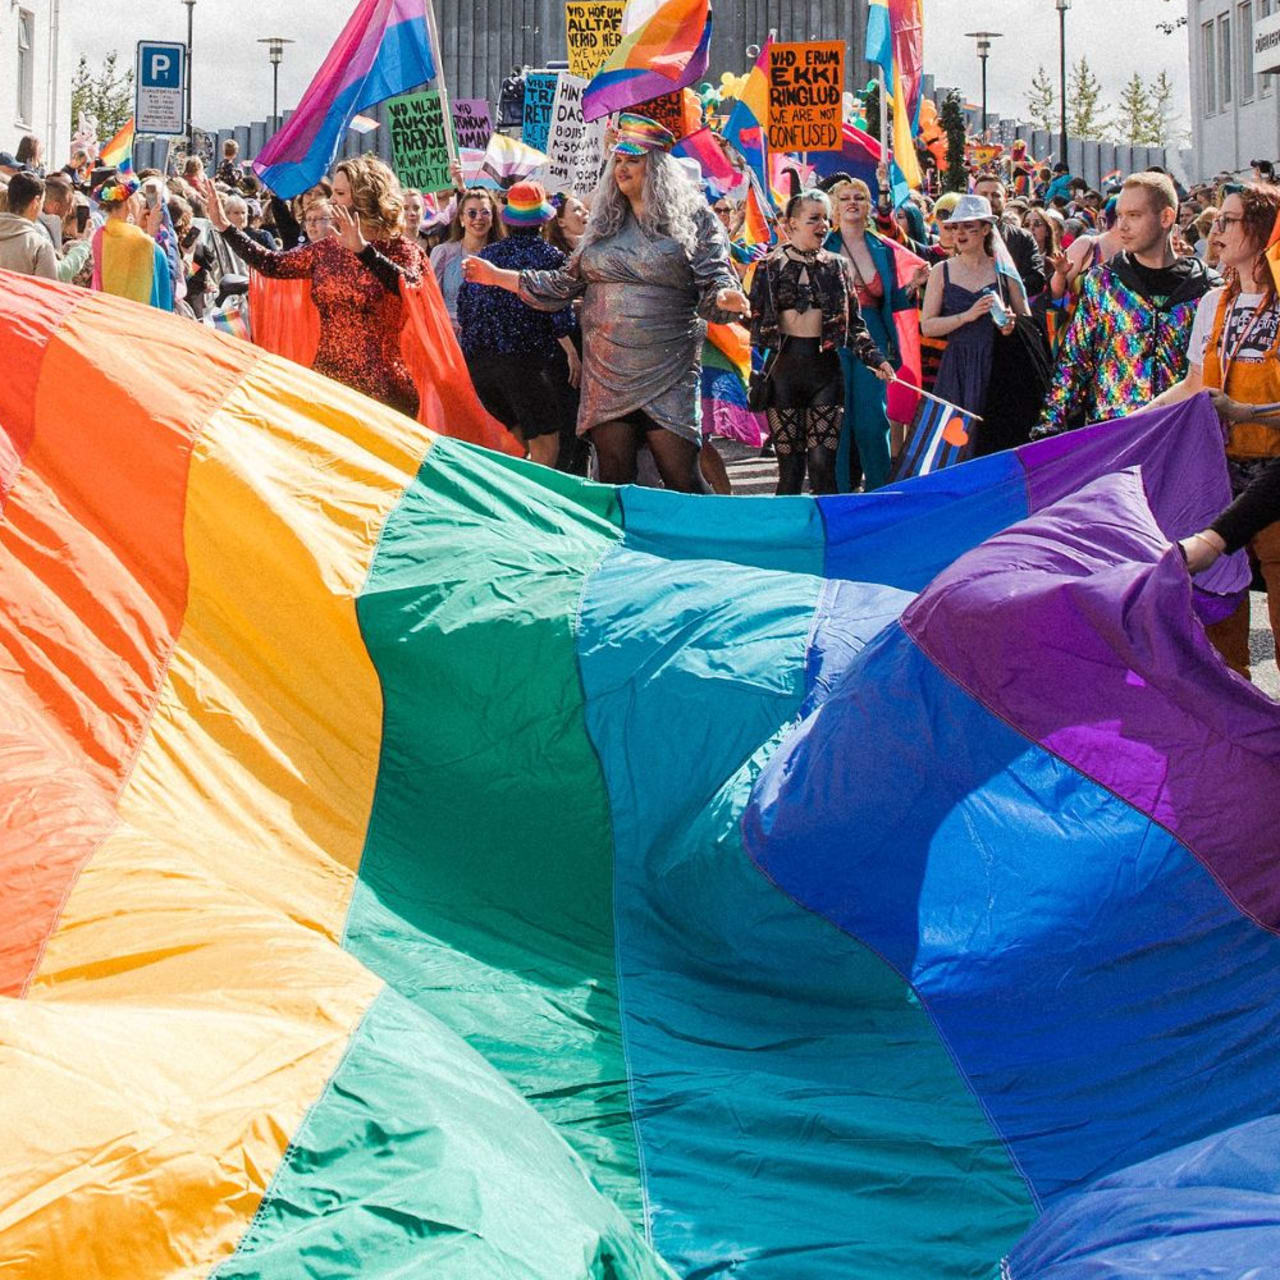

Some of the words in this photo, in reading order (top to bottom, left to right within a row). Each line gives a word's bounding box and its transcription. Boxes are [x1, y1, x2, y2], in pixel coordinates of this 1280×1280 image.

[568, 18, 623, 33] ALLTAF
[571, 48, 589, 59] WE
[592, 49, 615, 58] HAV
[805, 50, 840, 66] ERUM
[151, 54, 171, 81] P
[572, 59, 607, 71] ALWA
[770, 66, 839, 86] EKKI
[392, 112, 444, 130] AUKN
[770, 108, 788, 124] WE
[792, 108, 814, 122] ARE
[819, 107, 837, 120] NOT
[768, 123, 838, 148] CONFUSED
[429, 149, 450, 166] MOR
[398, 166, 453, 188] EDUCATIO
